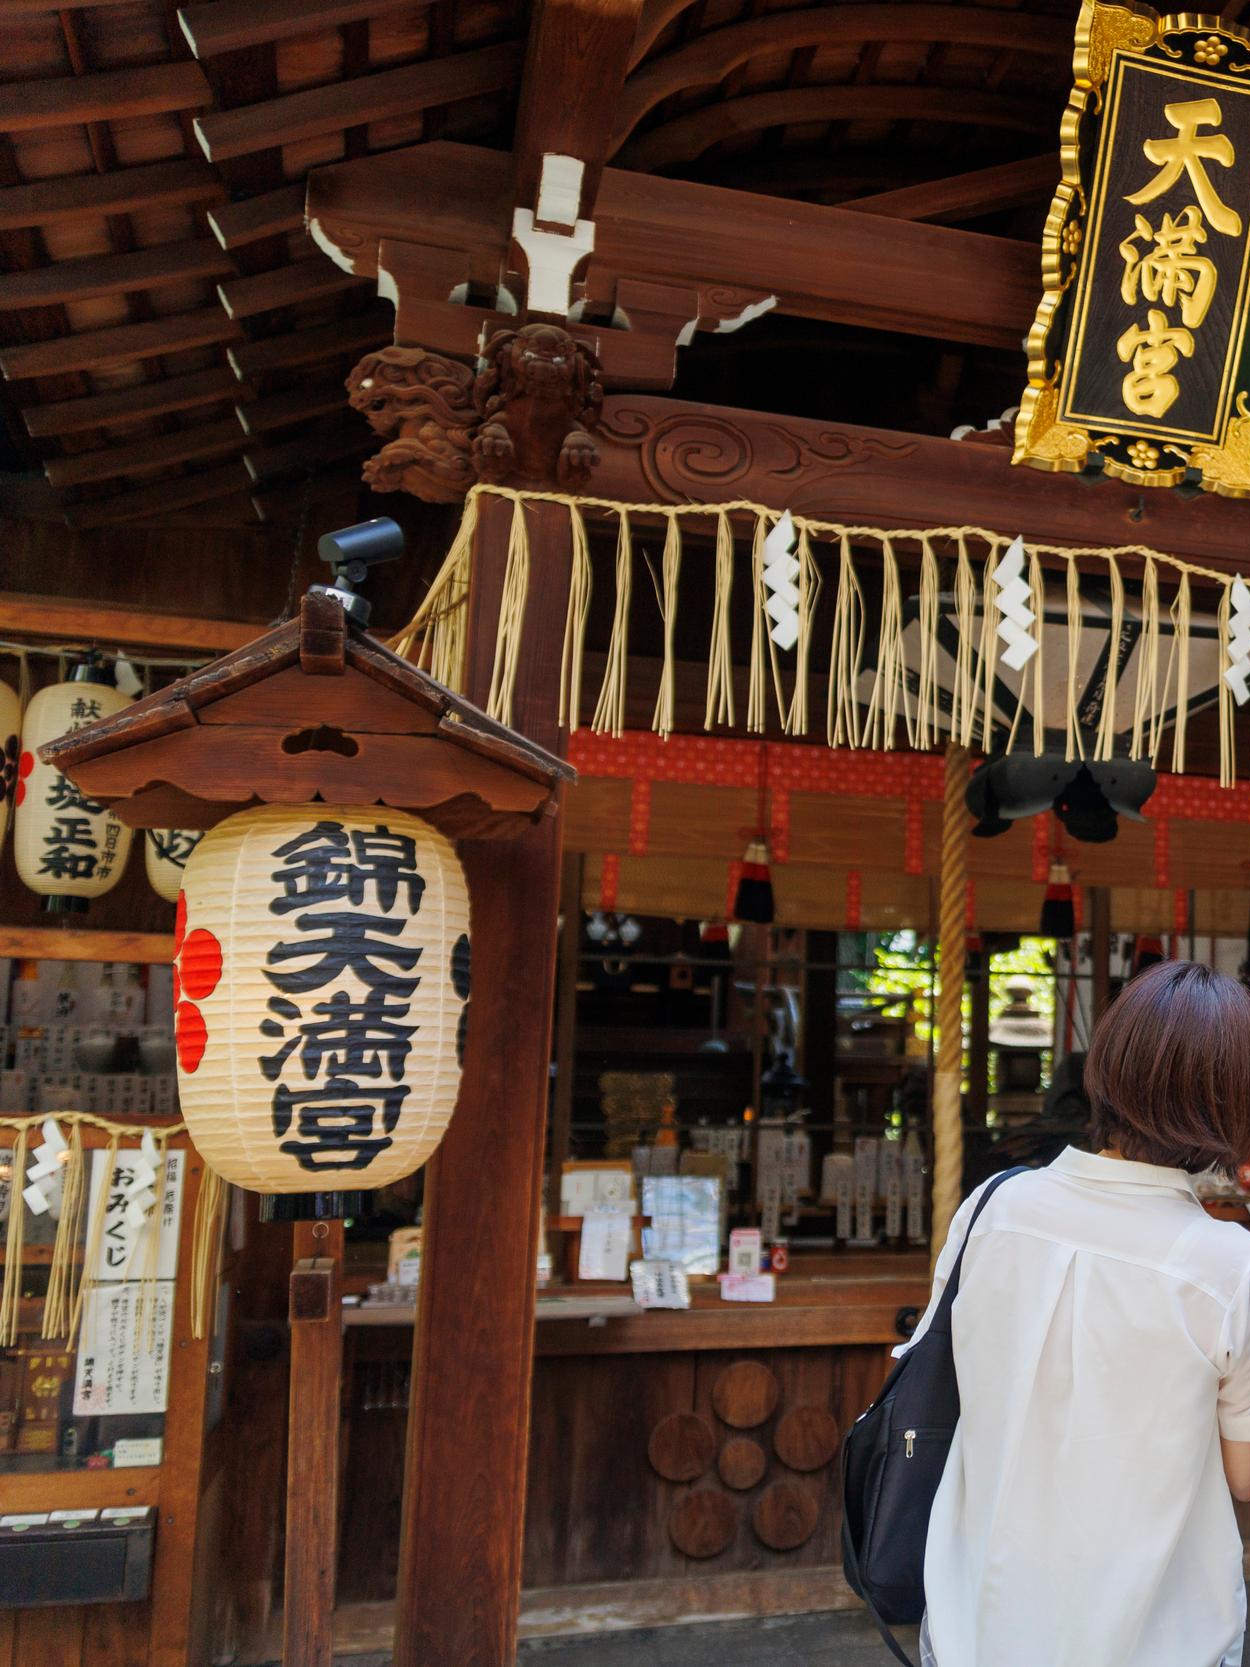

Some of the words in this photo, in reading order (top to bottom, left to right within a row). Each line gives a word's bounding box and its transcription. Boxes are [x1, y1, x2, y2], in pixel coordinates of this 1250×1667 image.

[1117, 97, 1243, 419] 天満宮
[257, 820, 426, 1173] 錦天満宮
[105, 1167, 136, 1267] おみくじ
